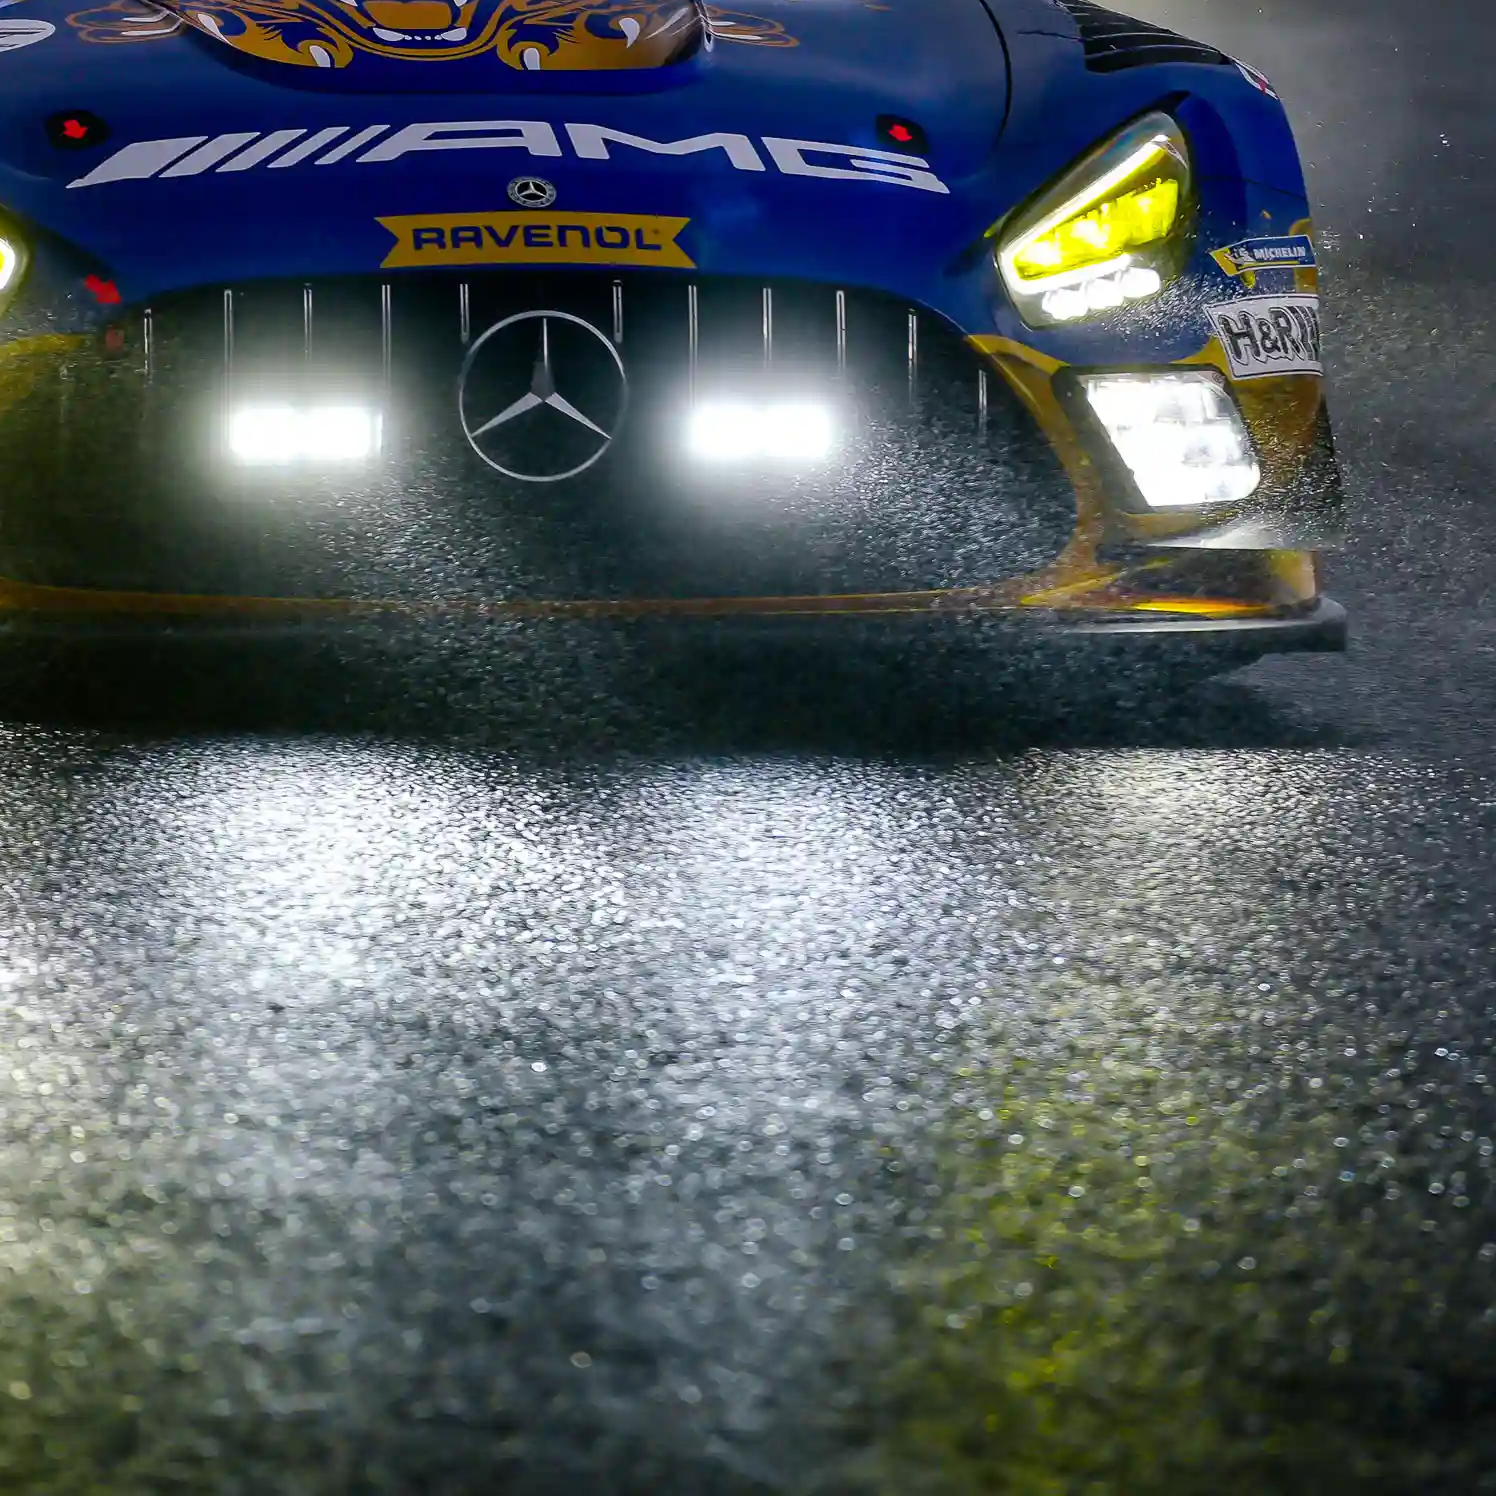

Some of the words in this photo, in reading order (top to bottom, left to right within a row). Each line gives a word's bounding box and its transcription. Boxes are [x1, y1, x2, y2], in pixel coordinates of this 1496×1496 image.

[357, 120, 951, 194] AMG
[412, 224, 662, 251] RAVENOL
[1253, 246, 1307, 260] MICHELIN
[1218, 307, 1305, 365] H&R
